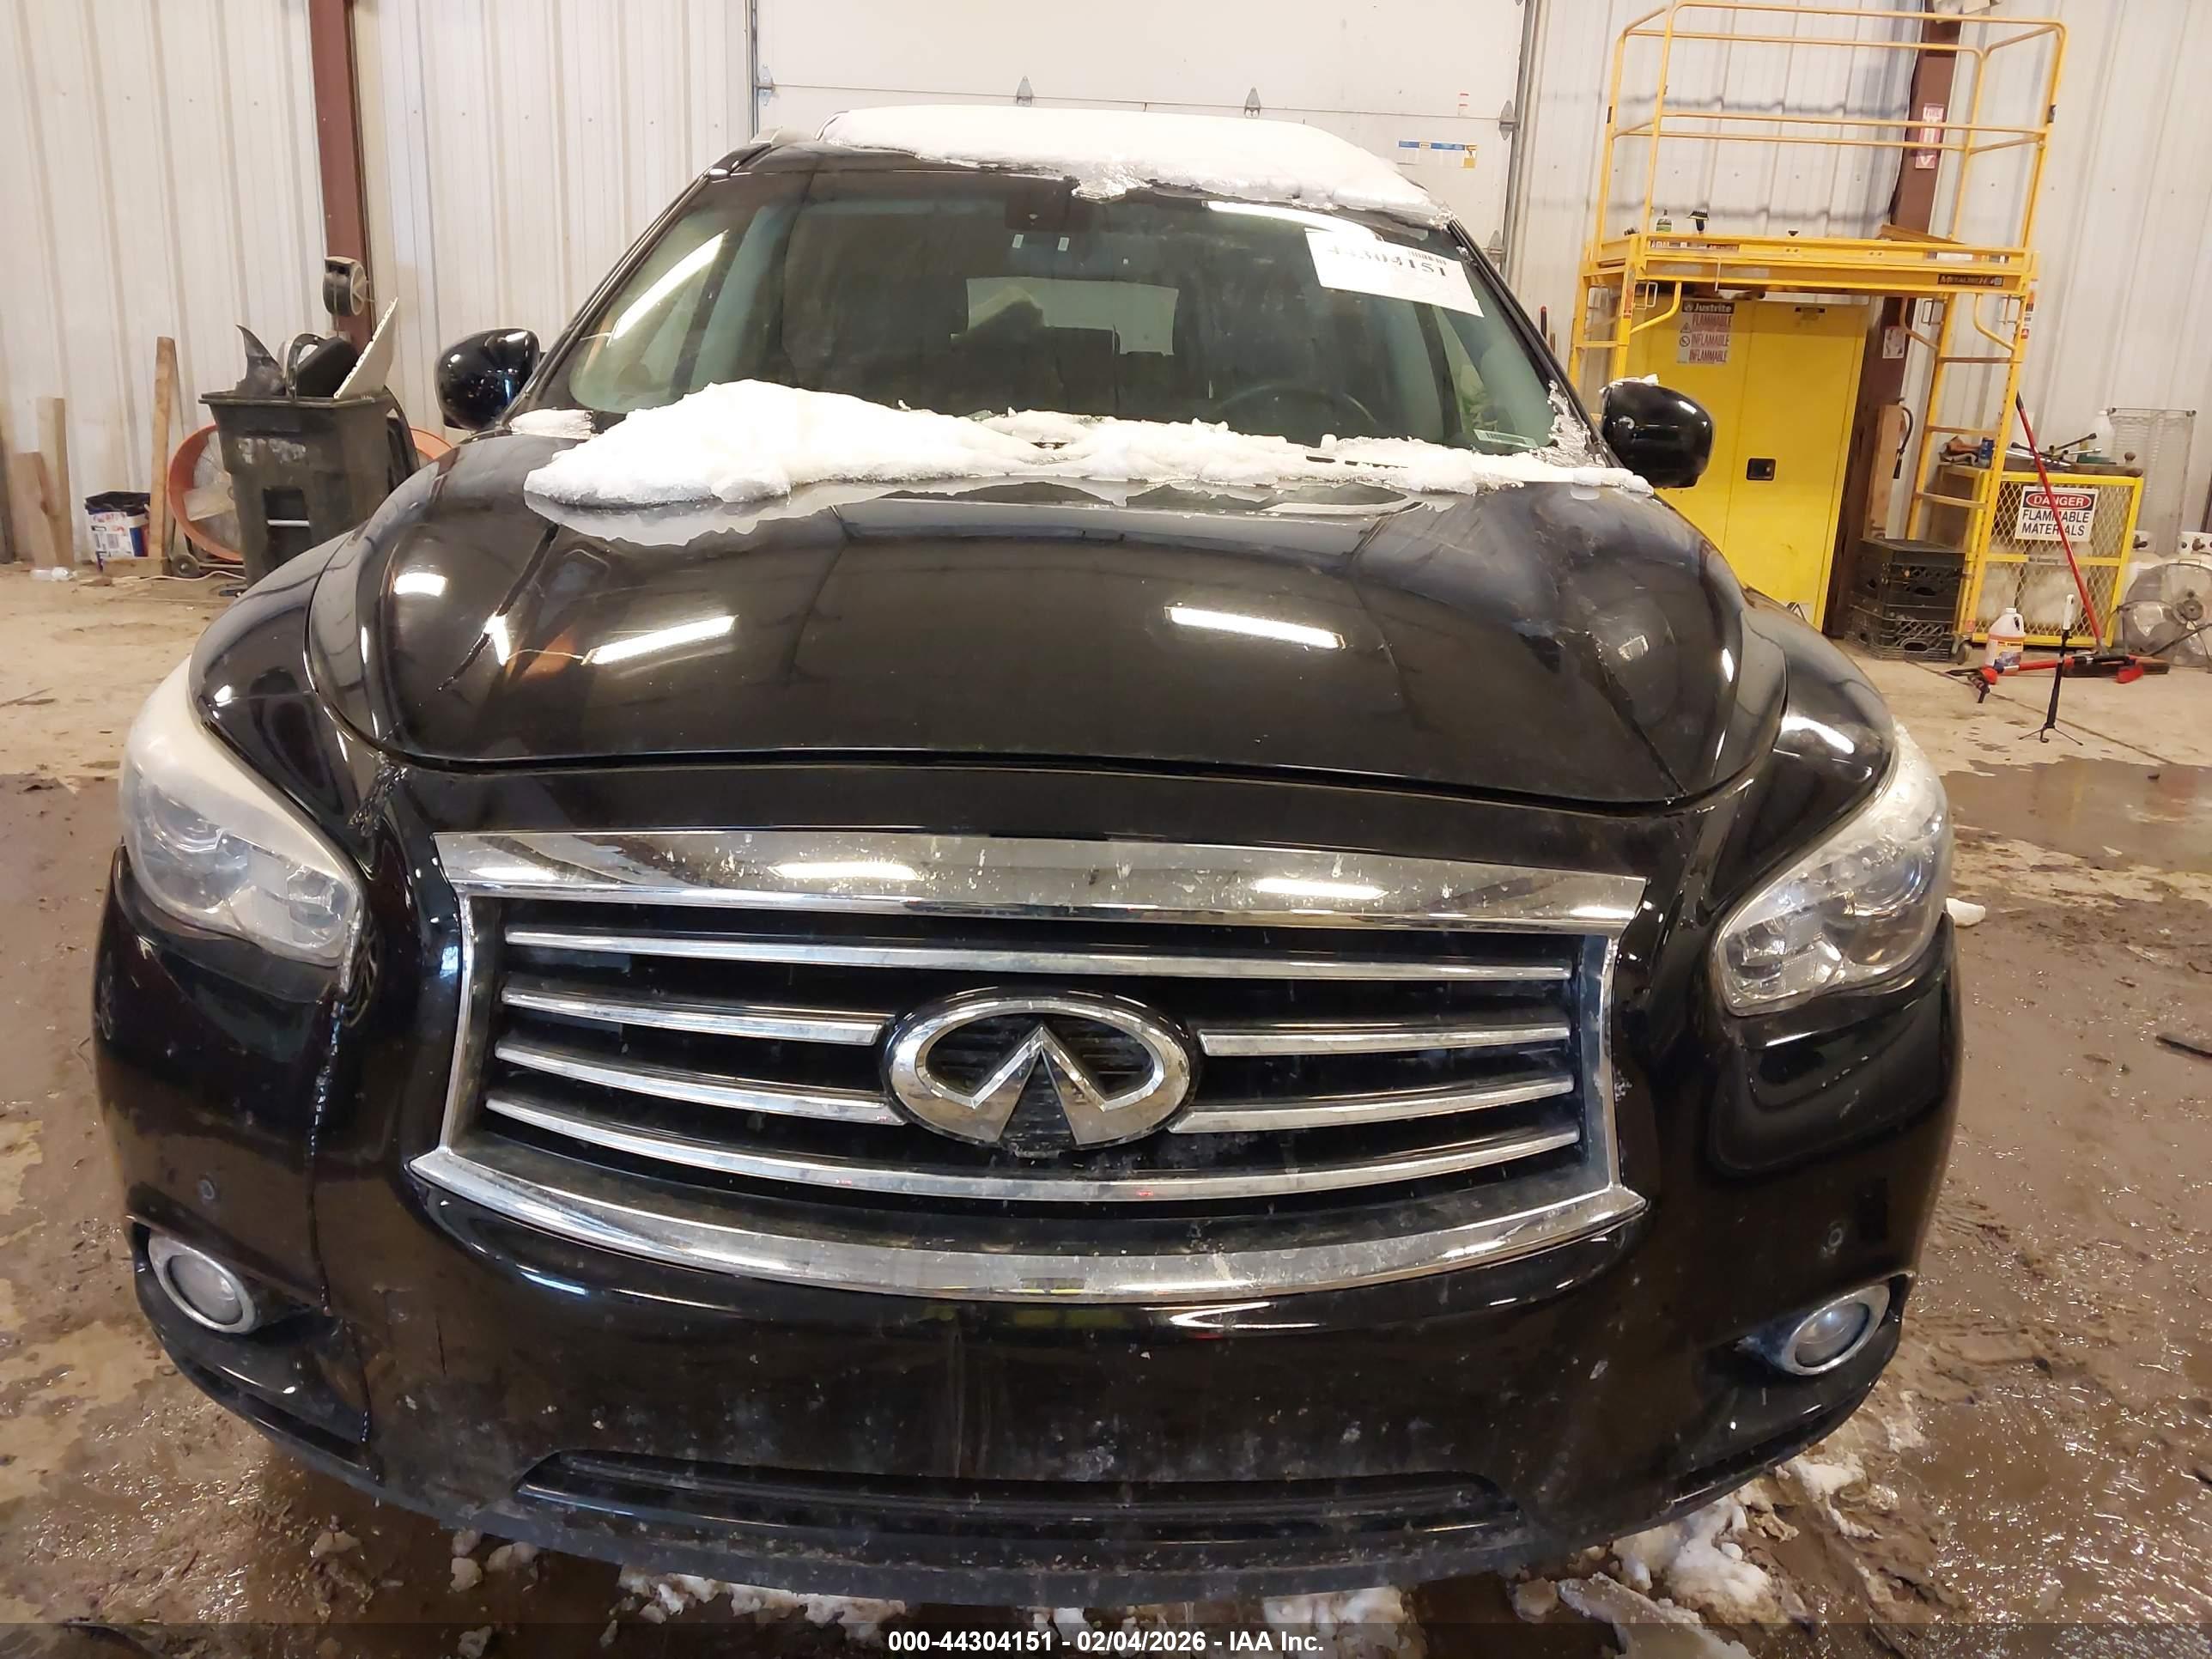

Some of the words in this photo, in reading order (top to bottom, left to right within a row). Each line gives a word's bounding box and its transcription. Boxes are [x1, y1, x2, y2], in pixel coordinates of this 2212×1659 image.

[1327, 245, 1446, 276] 4304151
[1694, 303, 1731, 313] Justrite
[1692, 313, 1732, 327] FLAMMABLE
[2021, 523, 2085, 536] MATERALS
